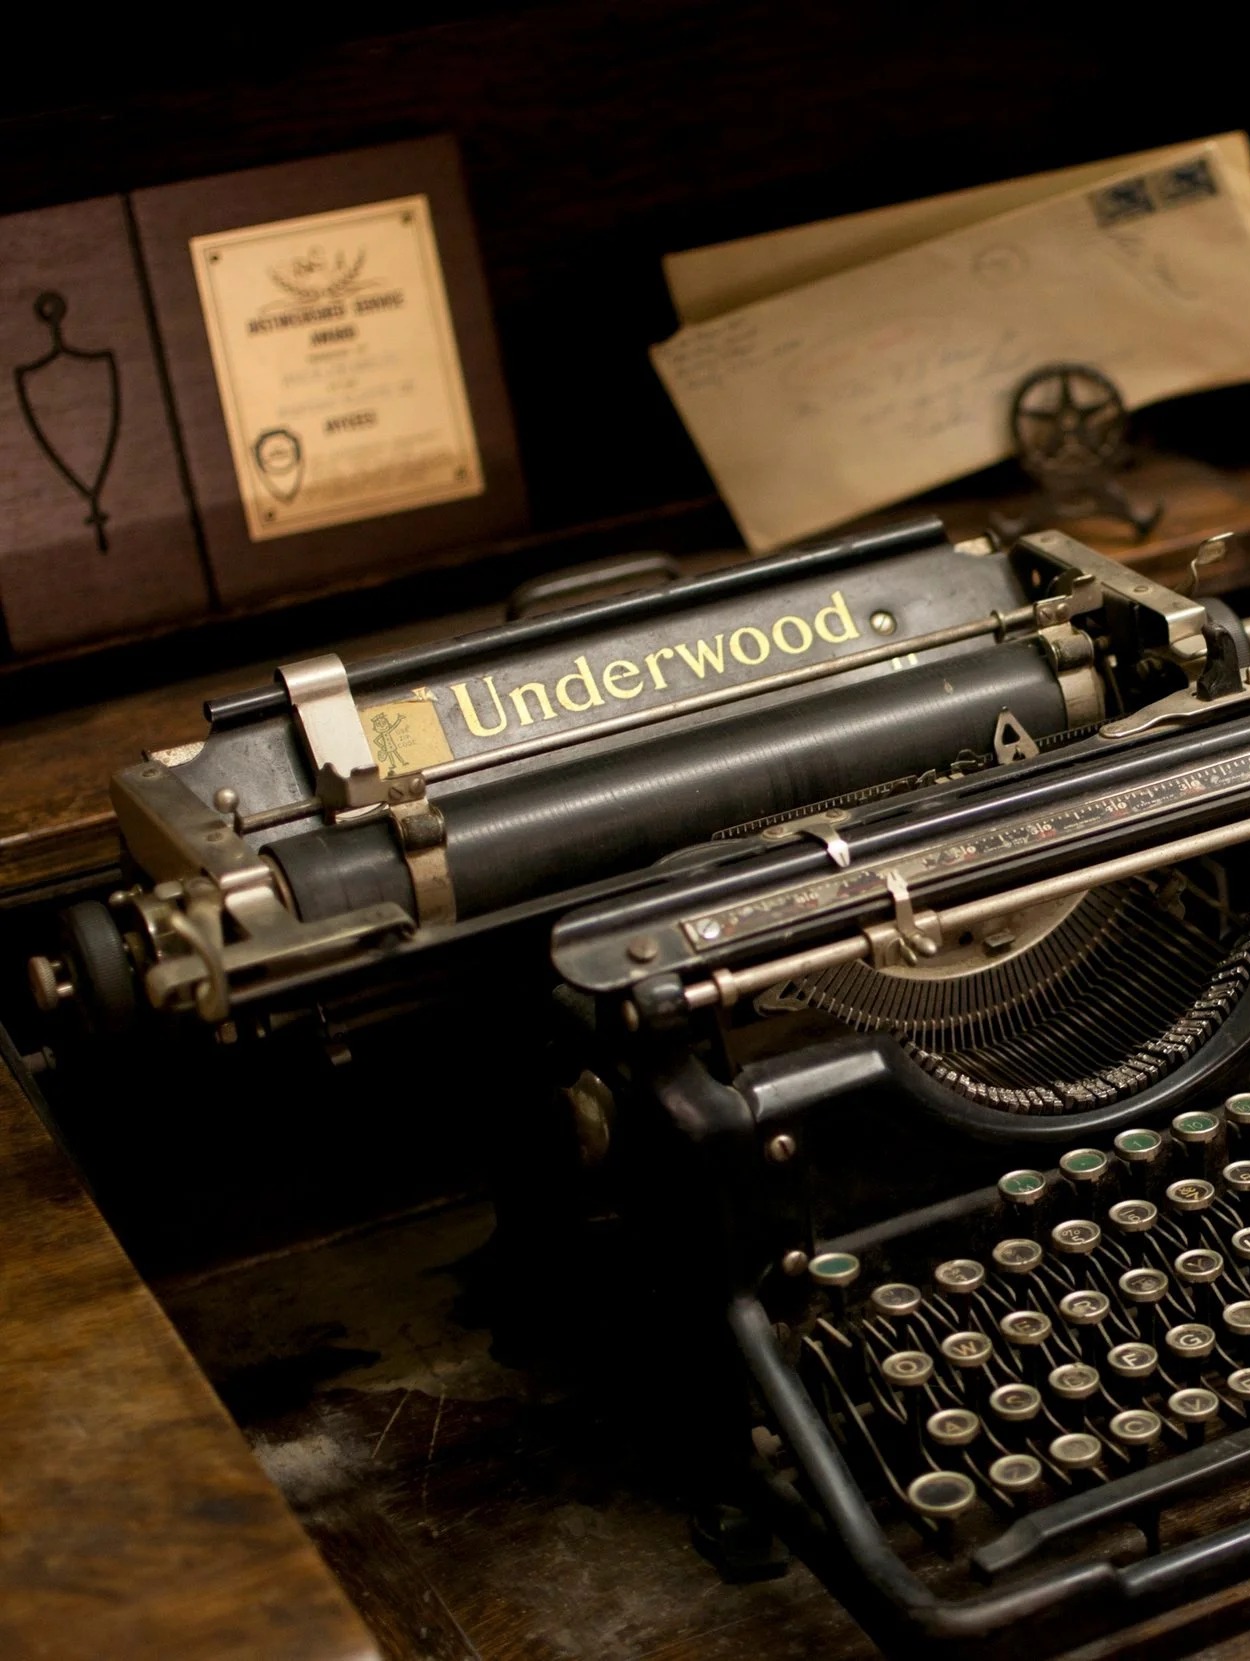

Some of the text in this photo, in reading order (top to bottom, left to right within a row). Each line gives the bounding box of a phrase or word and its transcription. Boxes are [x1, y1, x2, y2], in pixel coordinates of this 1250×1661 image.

[451, 591, 861, 738] Underwood
[1187, 1258, 1205, 1271] Y
[1180, 1334, 1203, 1347] G
[952, 1341, 977, 1355] W
[1122, 1353, 1138, 1367] F
[1183, 1398, 1200, 1411] V
[945, 1422, 962, 1433] A
[1124, 1421, 1145, 1434] C
